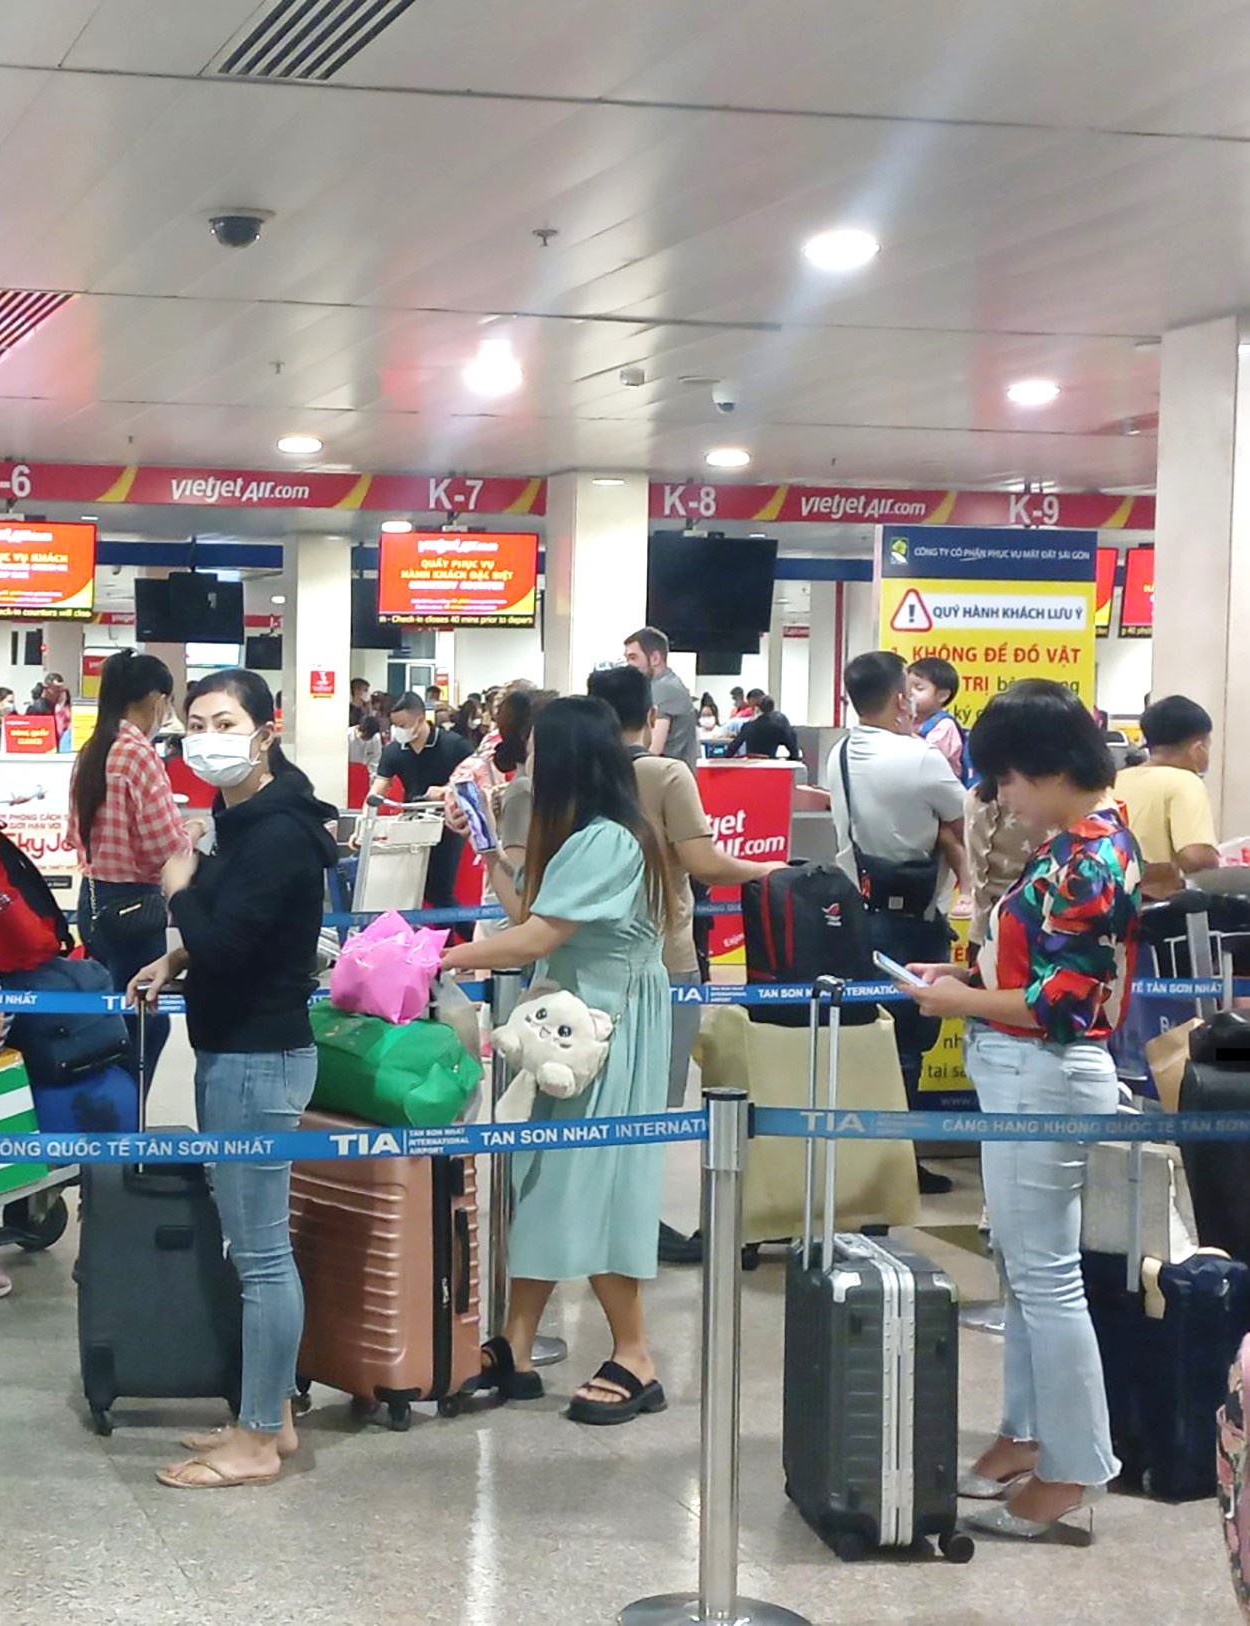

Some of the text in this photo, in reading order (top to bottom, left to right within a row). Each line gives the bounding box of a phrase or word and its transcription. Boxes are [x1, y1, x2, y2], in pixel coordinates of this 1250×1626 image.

[428, 478, 483, 510] K-7
[663, 485, 716, 516] K-8
[1008, 492, 1058, 525] K-9
[962, 604, 999, 618] HÀNH
[1002, 604, 1045, 619] KHÁCH
[1047, 645, 1081, 668] VẬT
[962, 676, 989, 695] TRỊ
[758, 989, 778, 999] TAN
[780, 989, 802, 999] SON
[800, 1111, 865, 1133] TIA
[47, 1135, 101, 1157] QUỐC
[107, 1134, 130, 1156] TẾ
[136, 1136, 172, 1156] TÂN
[178, 1136, 219, 1156] SƠN
[224, 1135, 275, 1156] NHẤT
[330, 1133, 400, 1156] TIA
[480, 1130, 516, 1146] TAN
[520, 1128, 558, 1144] SON
[563, 1125, 610, 1142] NHAT
